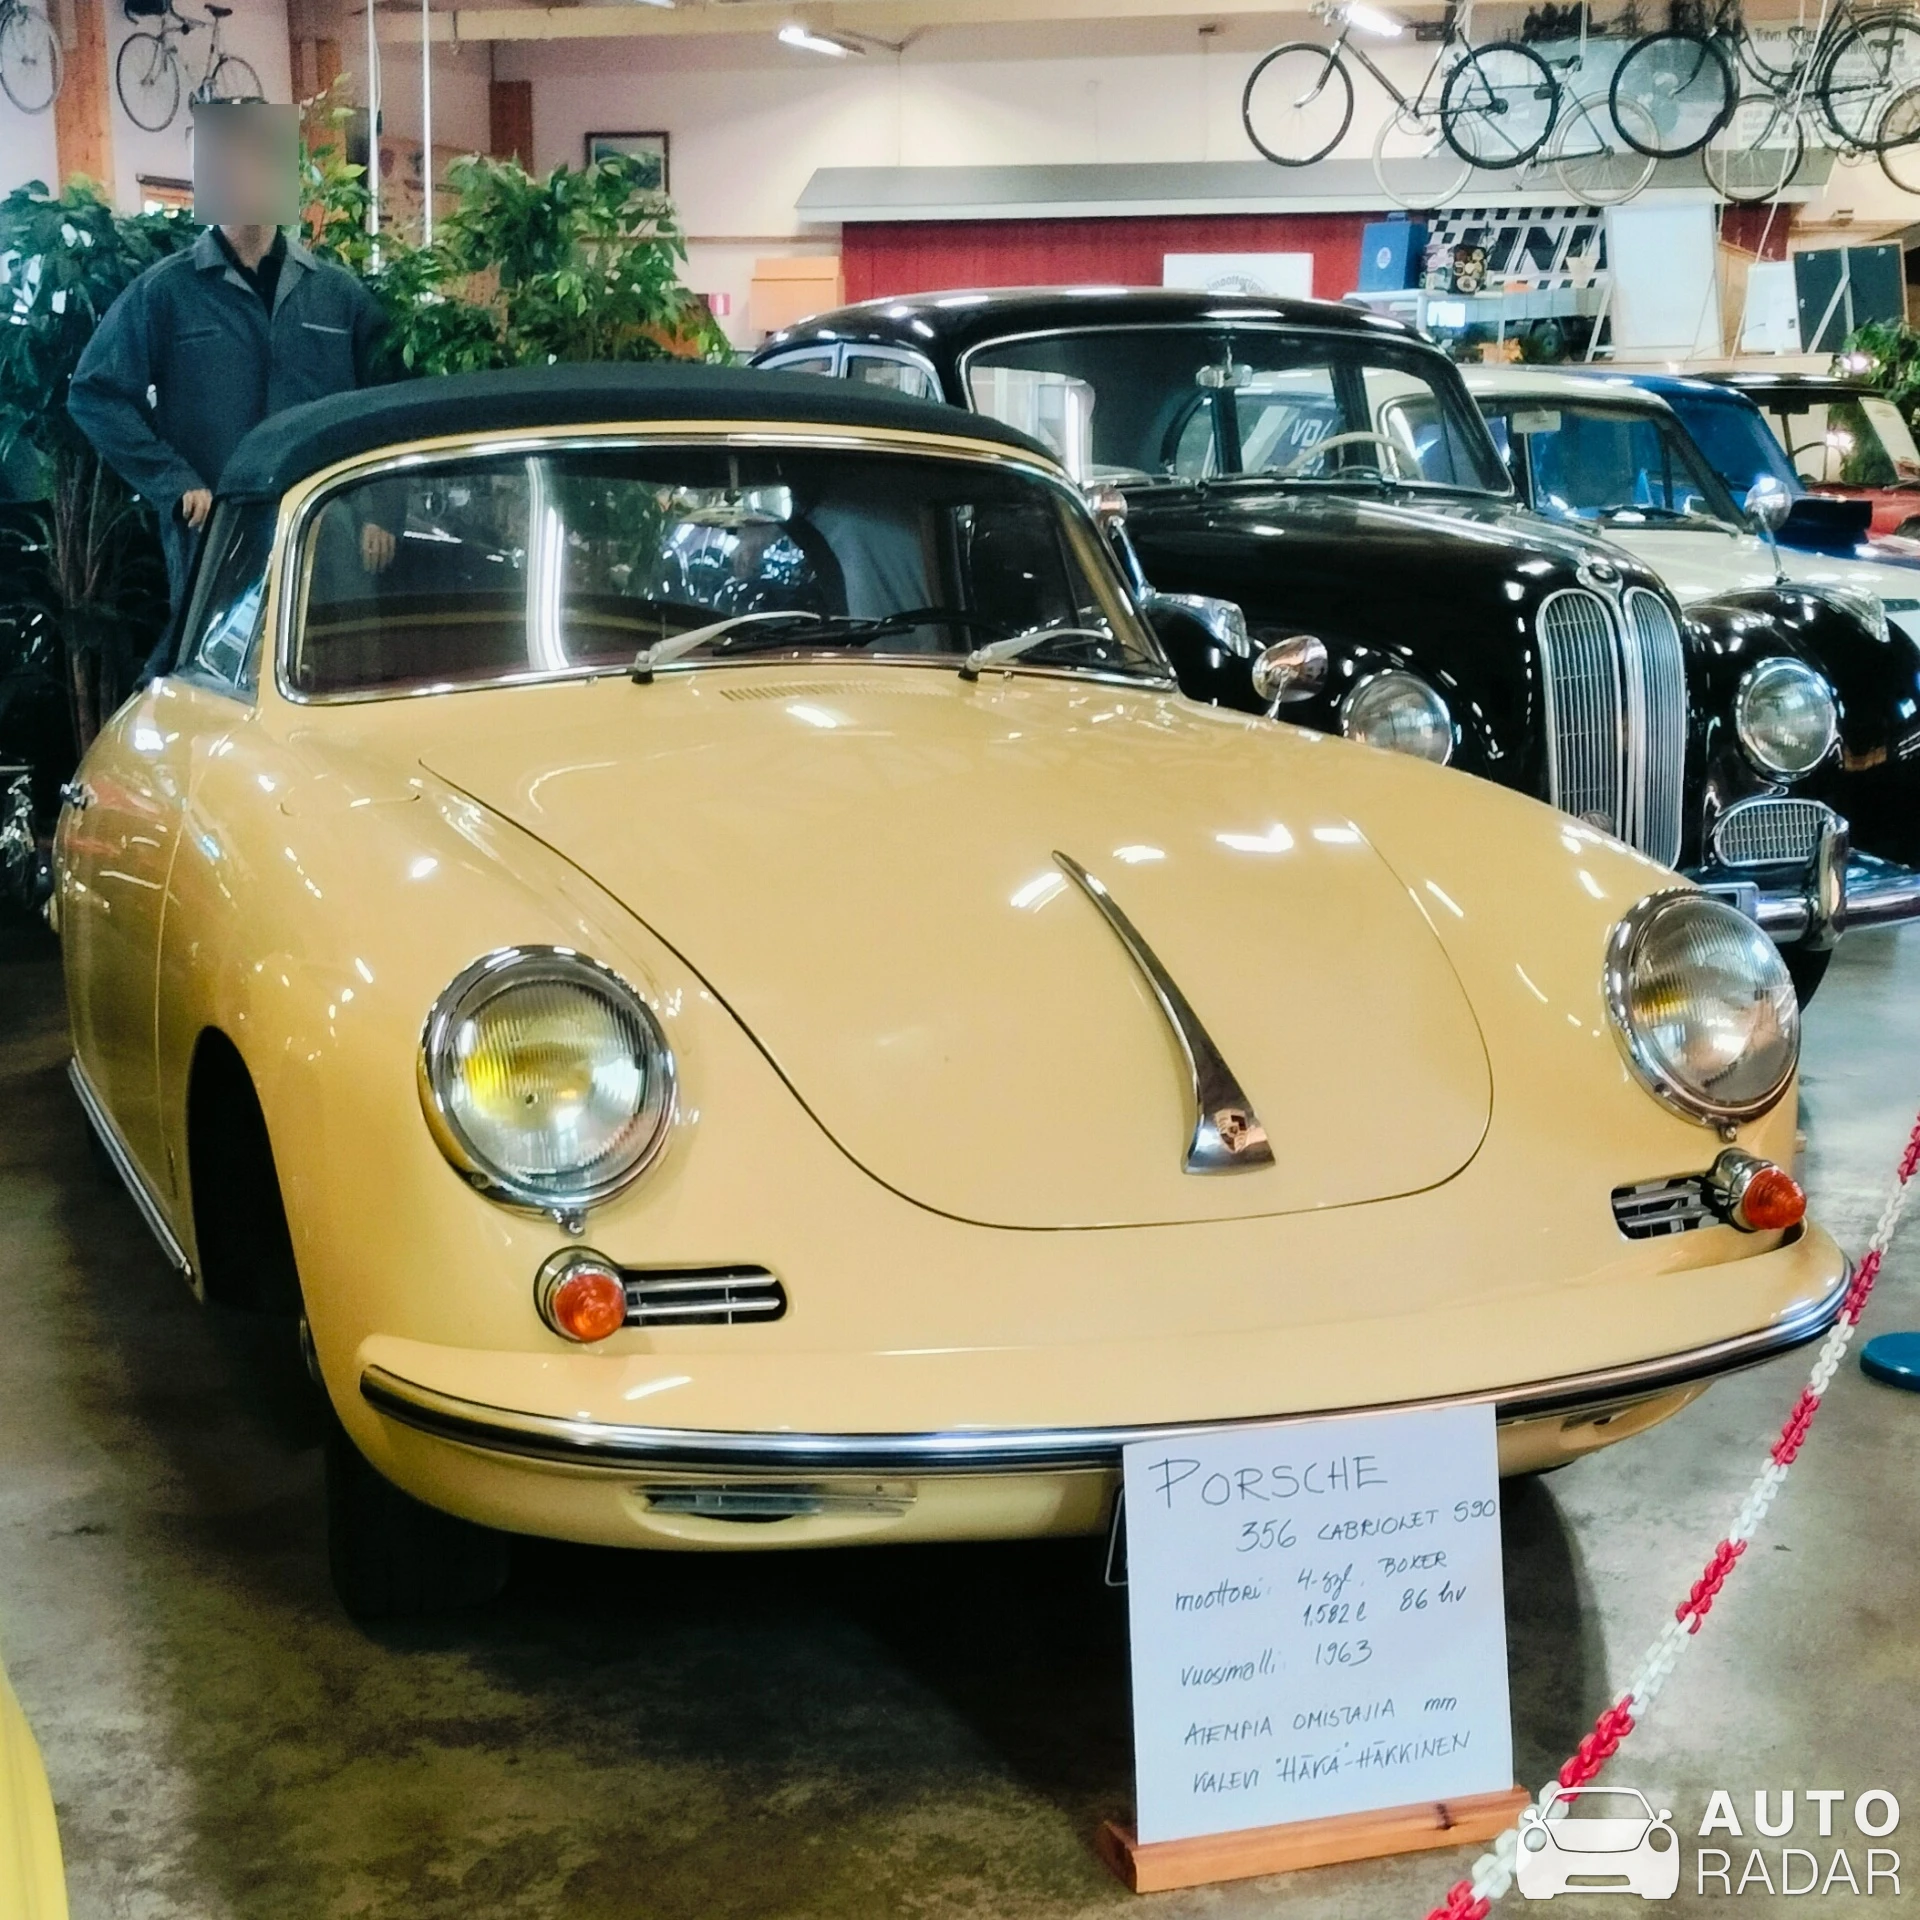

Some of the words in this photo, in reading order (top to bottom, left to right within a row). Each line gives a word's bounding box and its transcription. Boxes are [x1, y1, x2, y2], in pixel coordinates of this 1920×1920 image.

[1148, 1455, 1388, 1509] PORSCHE
[1235, 1518, 1298, 1553] 356
[1317, 1508, 1439, 1541] CABRIOLET
[1453, 1498, 1497, 1522] S90
[1377, 1550, 1448, 1577] BOXER
[1399, 1586, 1429, 1612] 86
[1438, 1579, 1468, 1603] hv
[1315, 1638, 1373, 1667] 1963
[1292, 1698, 1396, 1730] OMISTAJIA
[1423, 1696, 1458, 1712] mm
[1193, 1768, 1260, 1794] KALEVI
